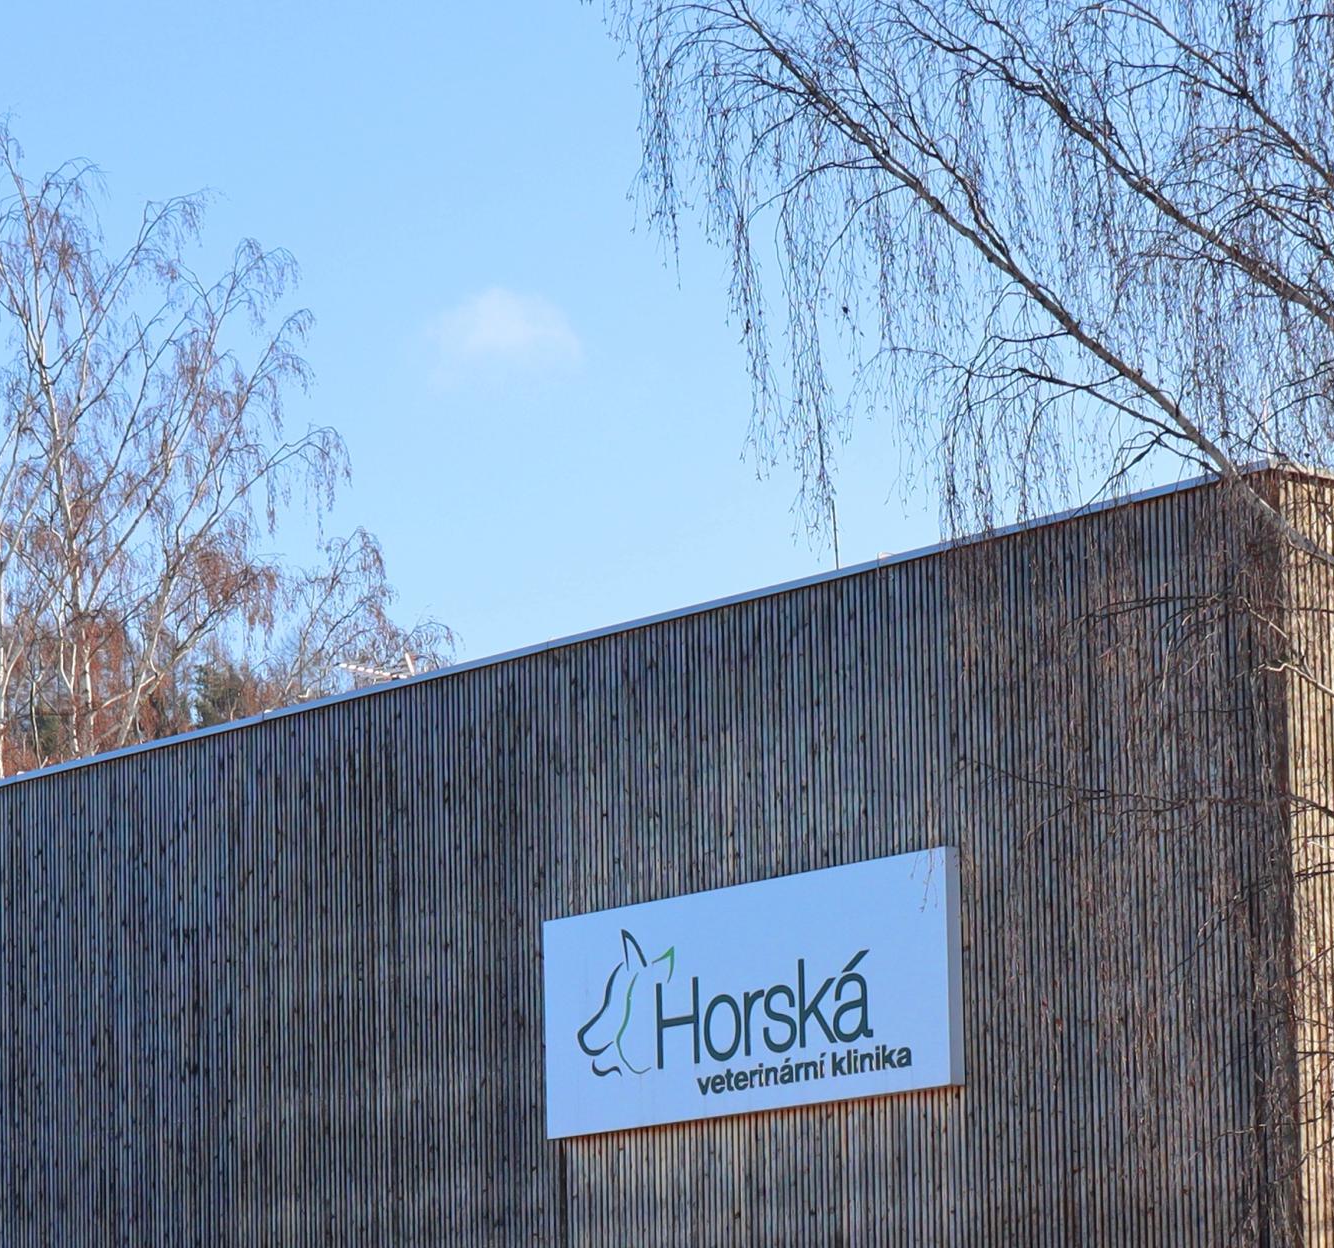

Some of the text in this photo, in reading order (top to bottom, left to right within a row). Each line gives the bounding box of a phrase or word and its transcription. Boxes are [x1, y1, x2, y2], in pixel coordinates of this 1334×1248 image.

[655, 949, 874, 1070] Horská
[696, 1044, 913, 1096] veterinární klinika
